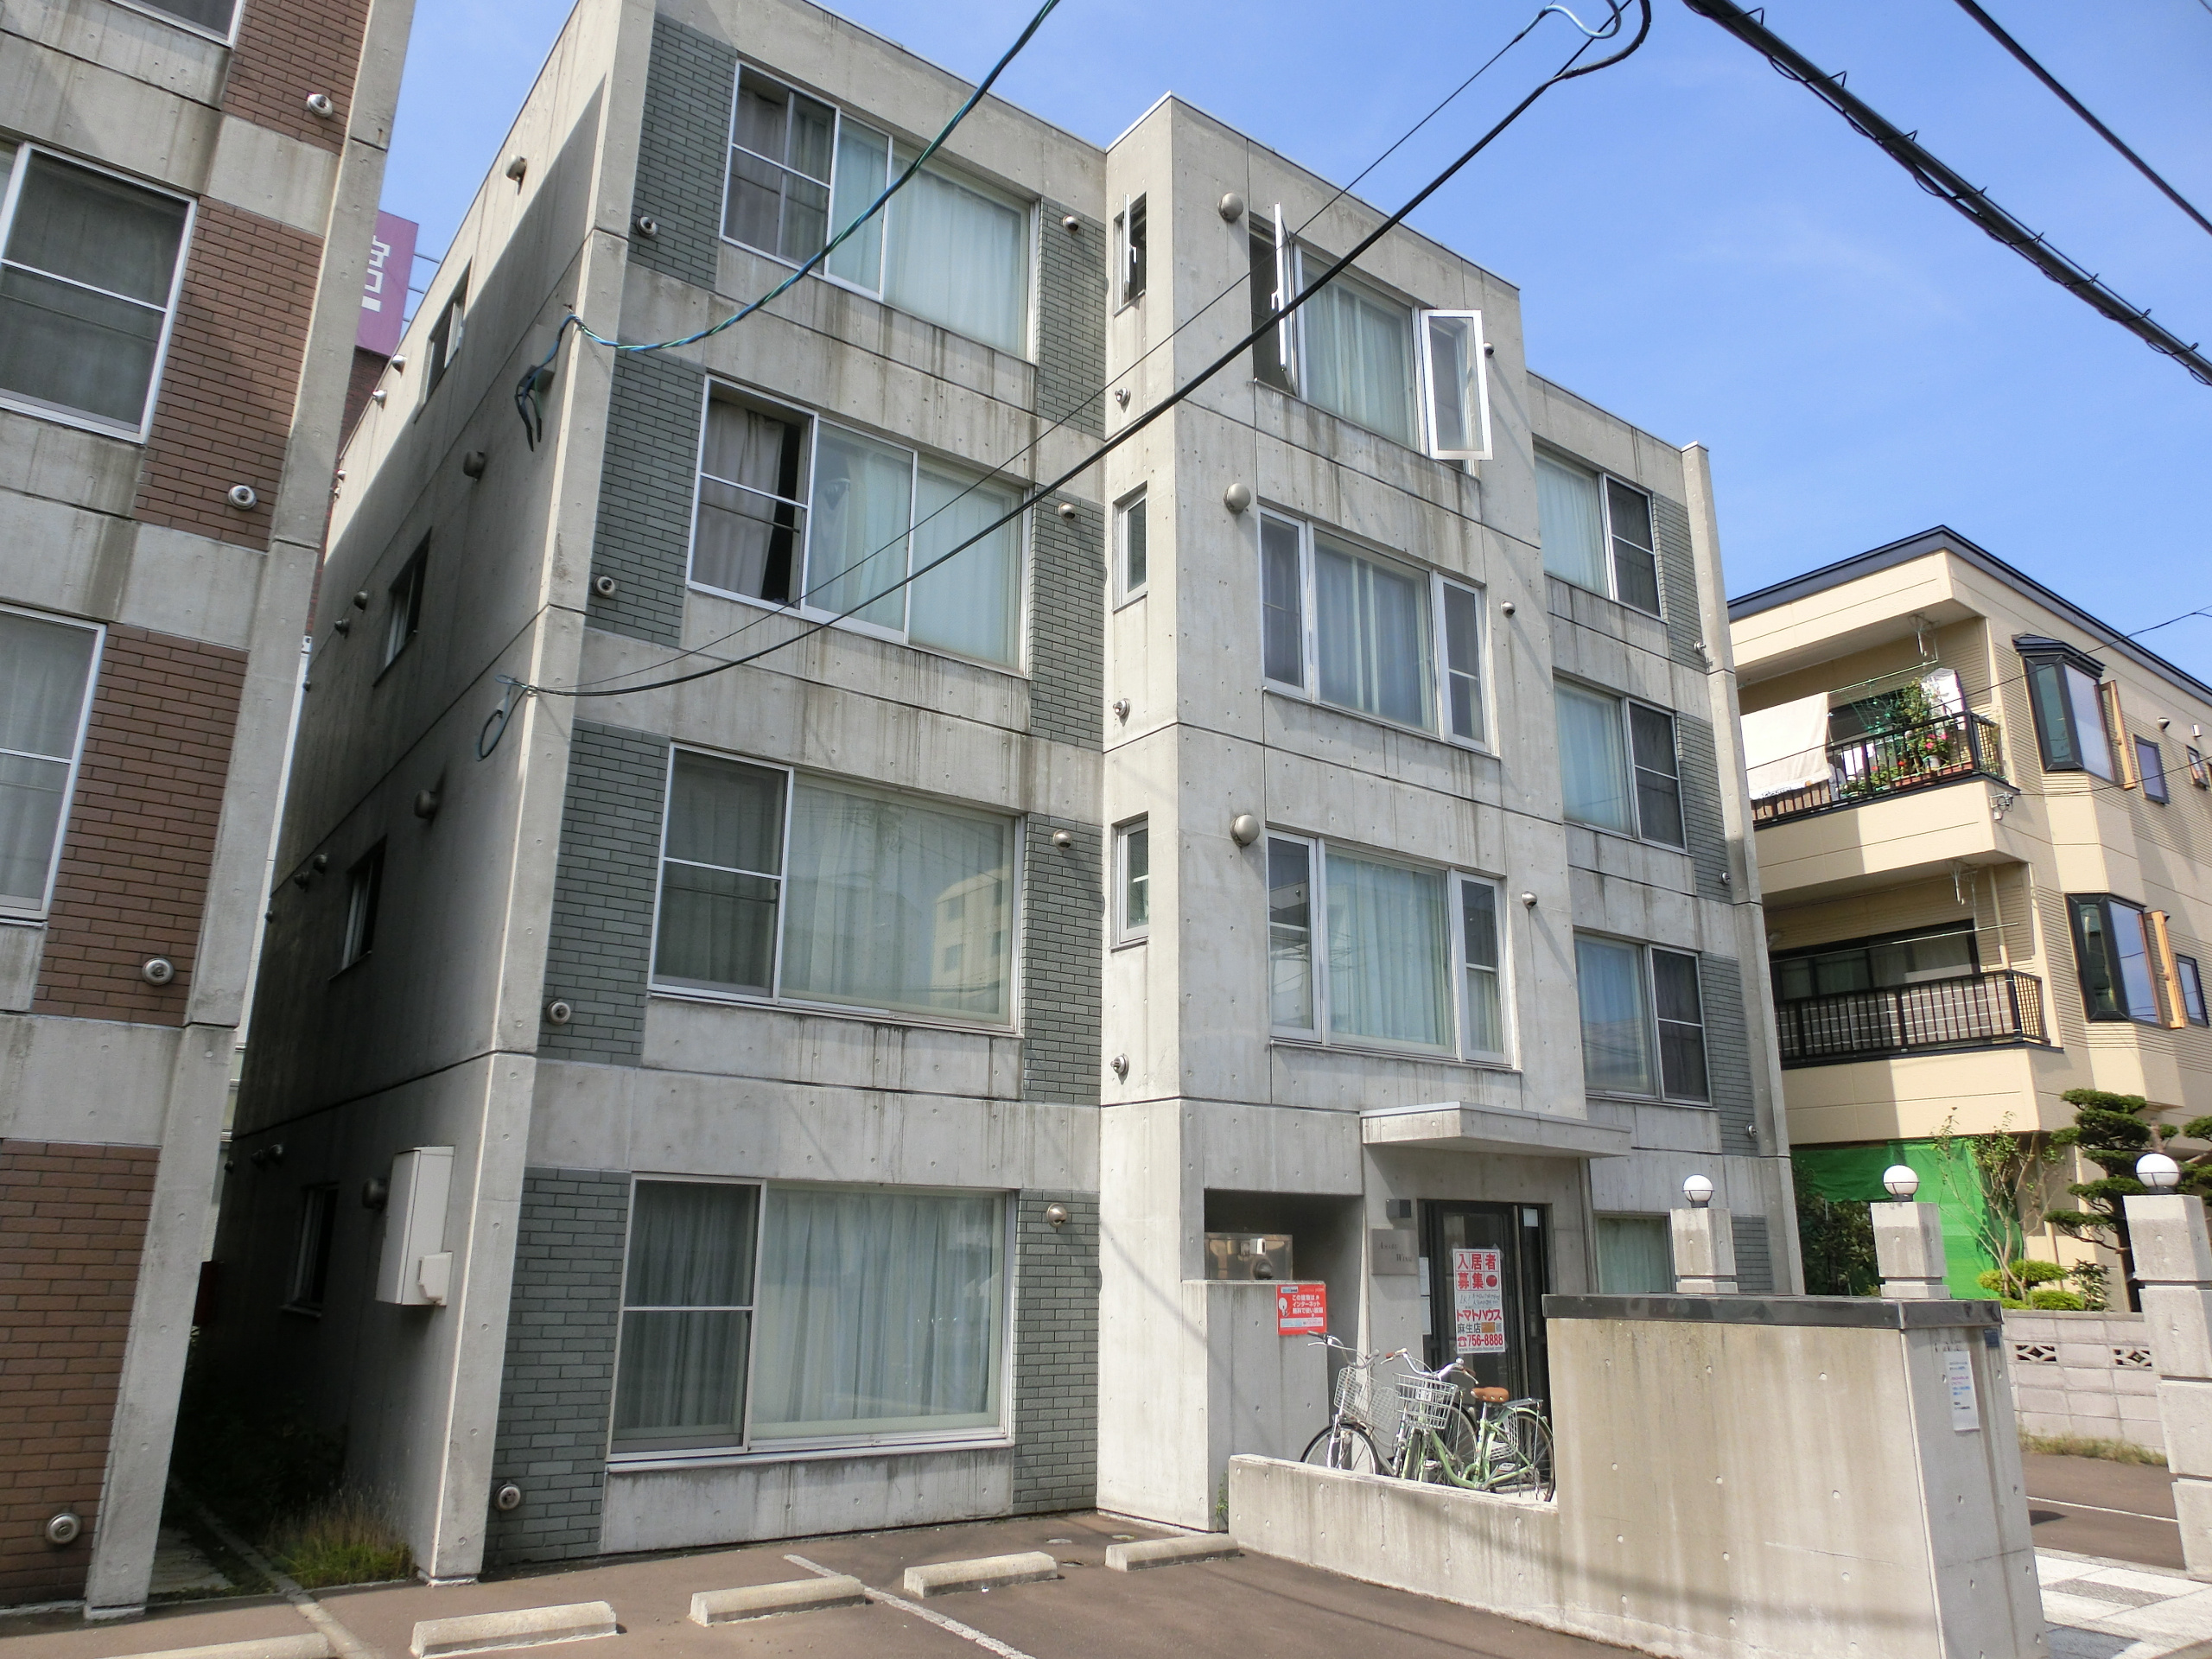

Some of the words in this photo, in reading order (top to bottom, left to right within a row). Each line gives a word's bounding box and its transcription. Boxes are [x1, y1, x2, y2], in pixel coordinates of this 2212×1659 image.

[1458, 1253, 1496, 1270] 入居者
[1458, 1272, 1484, 1289] 募集
[1457, 1308, 1502, 1322] トマトハウス
[1458, 1323, 1481, 1334] 麻生店
[1467, 1334, 1503, 1346] 756-8888
